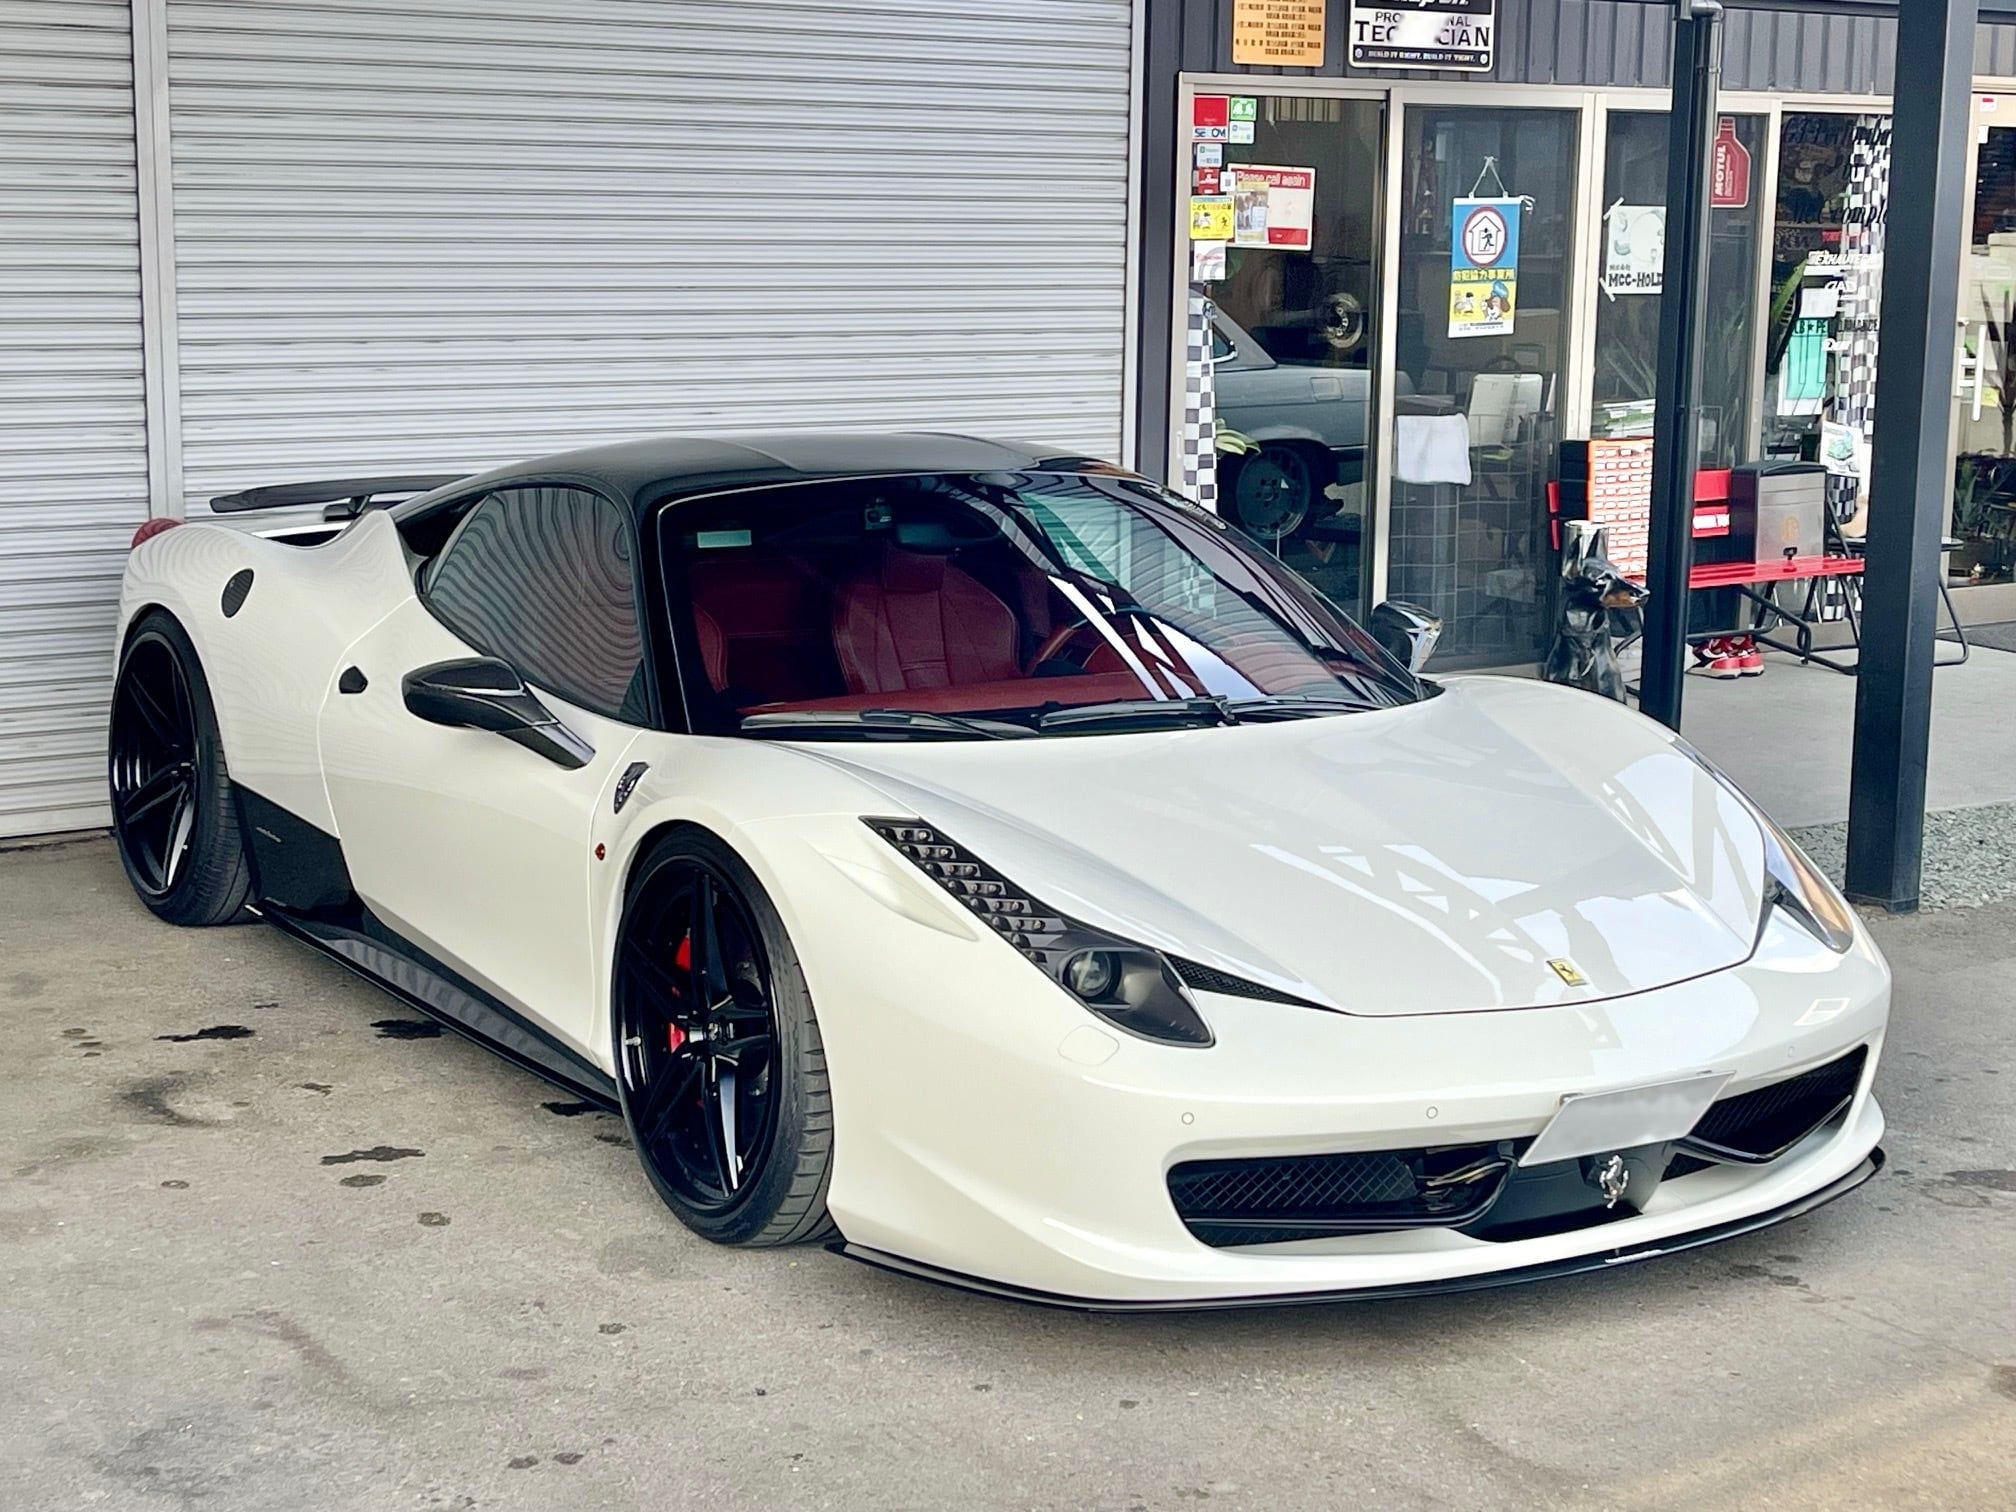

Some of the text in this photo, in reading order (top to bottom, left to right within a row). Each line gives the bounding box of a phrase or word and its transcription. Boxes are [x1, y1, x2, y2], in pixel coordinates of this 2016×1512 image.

[1375, 11, 1471, 27] PRONAL
[1355, 20, 1490, 47] TECCIAN
[1194, 127, 1226, 138] SEOM
[1714, 145, 1727, 197] MOTUL
[1266, 172, 1281, 185] call
[1281, 174, 1306, 187] again
